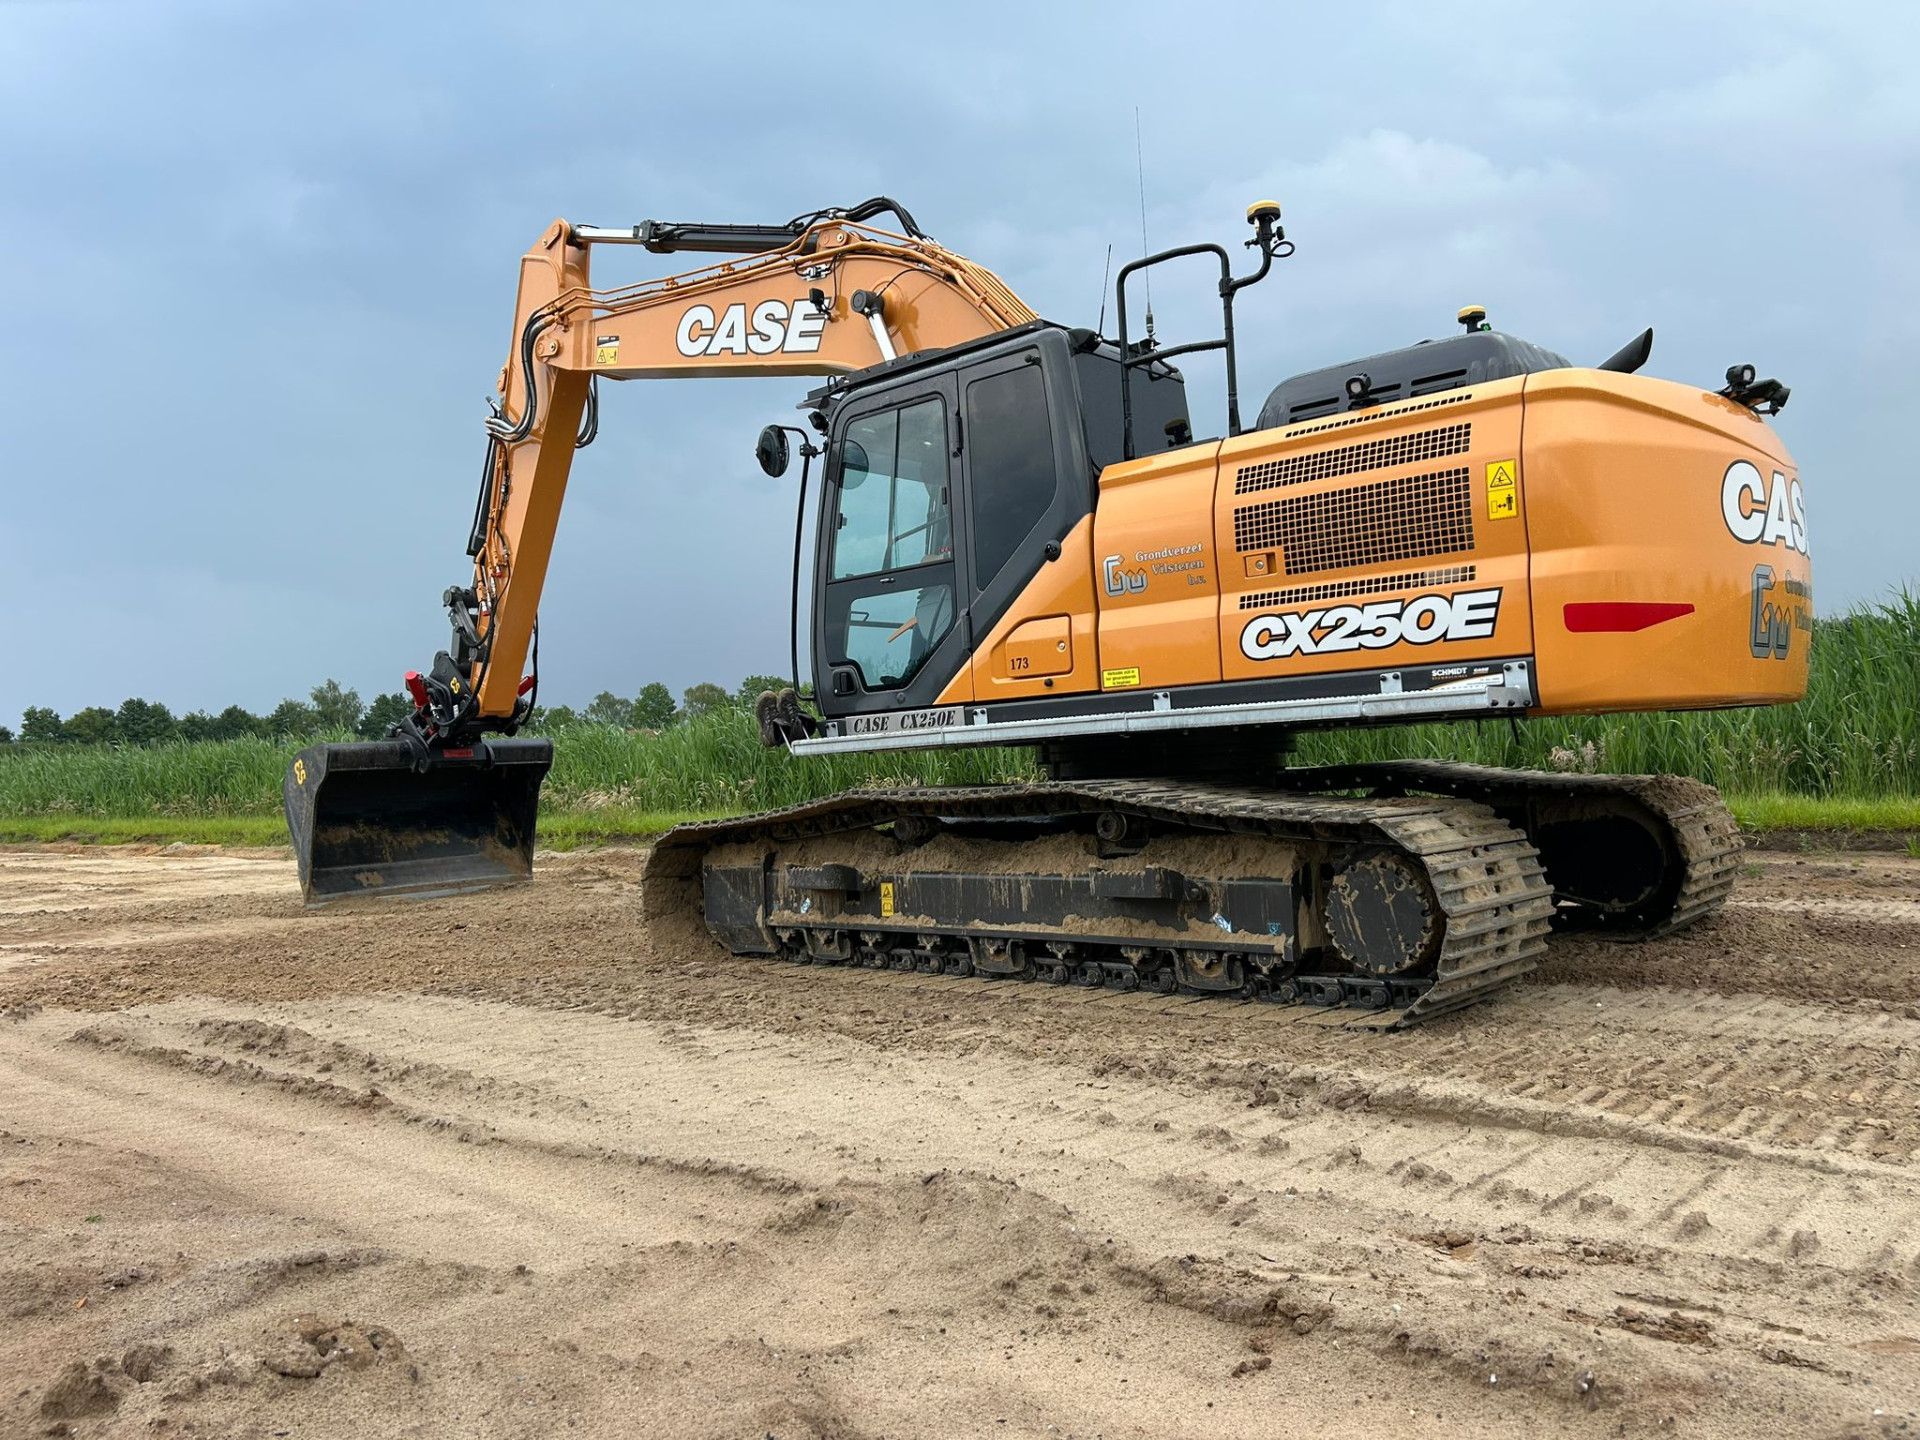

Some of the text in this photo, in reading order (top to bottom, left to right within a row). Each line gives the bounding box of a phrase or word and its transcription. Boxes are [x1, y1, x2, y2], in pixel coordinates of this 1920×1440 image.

[676, 297, 831, 357] CASE
[1721, 459, 1810, 560] CAS
[1135, 543, 1203, 562] Grondverzet
[1151, 560, 1205, 575] Vilsteren
[1240, 587, 1503, 661] CX250E
[1010, 657, 1029, 670] 173
[1431, 667, 1468, 677] SCHMIDT
[854, 710, 956, 733] CASE CX250E
